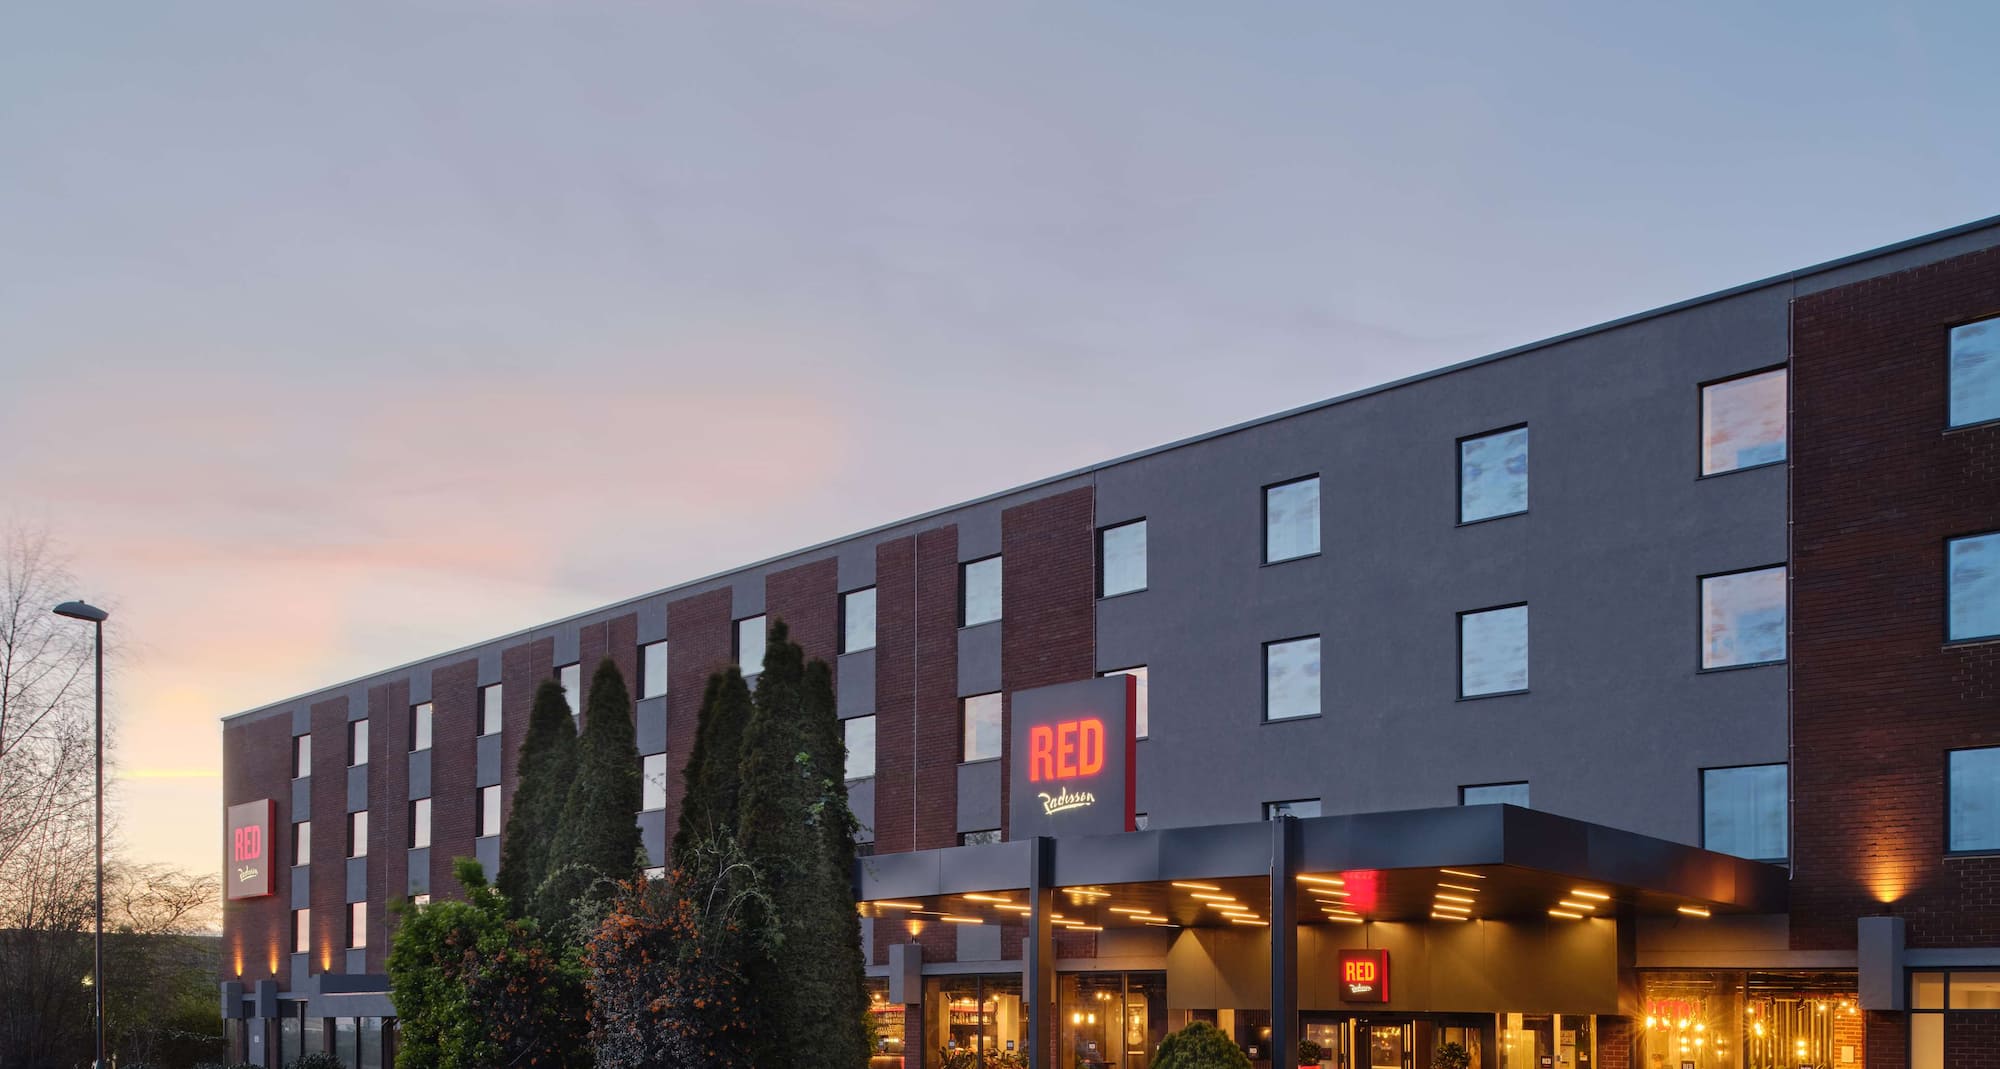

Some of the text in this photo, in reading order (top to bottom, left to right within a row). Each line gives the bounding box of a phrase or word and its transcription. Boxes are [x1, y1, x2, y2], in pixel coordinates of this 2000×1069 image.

[1030, 718, 1104, 782] RED
[1037, 786, 1096, 815] Radisson
[234, 825, 261, 862] RED
[1345, 961, 1375, 982] RED
